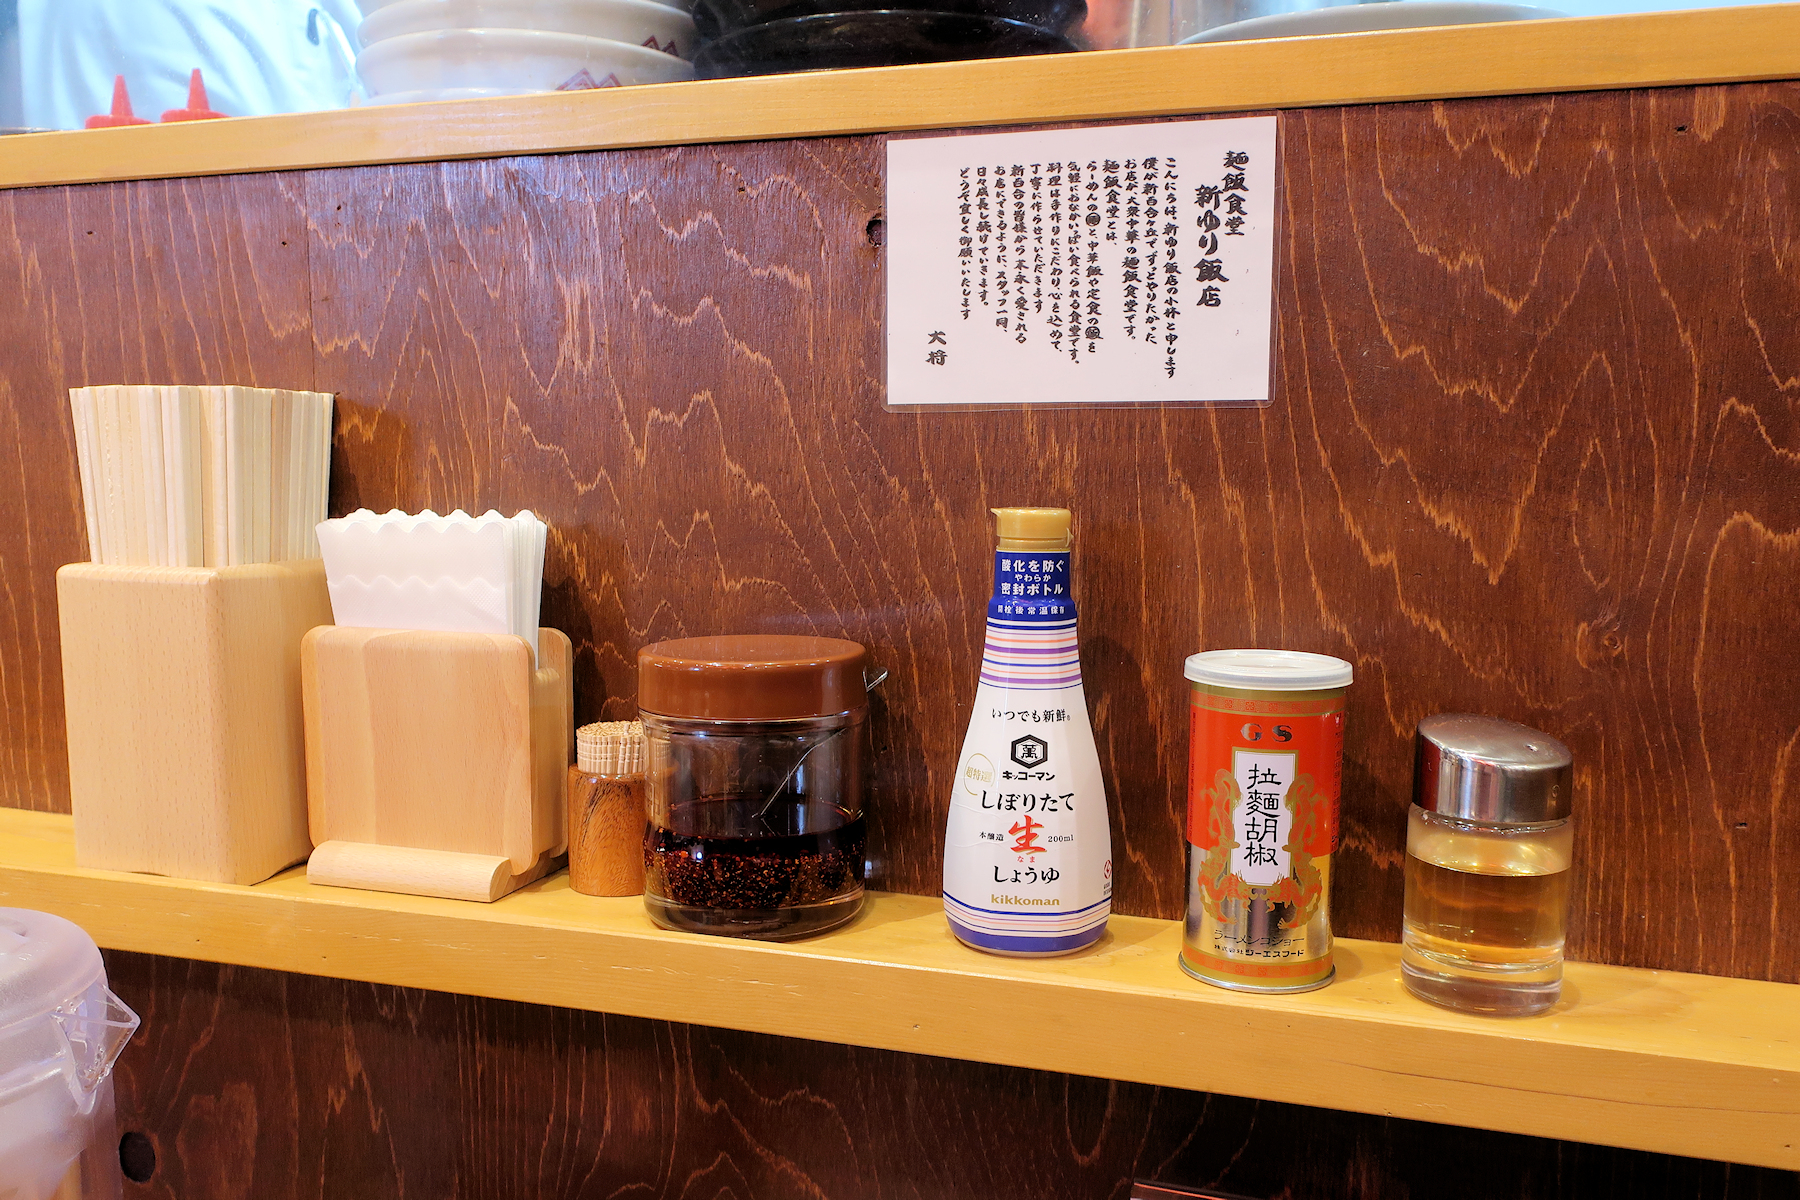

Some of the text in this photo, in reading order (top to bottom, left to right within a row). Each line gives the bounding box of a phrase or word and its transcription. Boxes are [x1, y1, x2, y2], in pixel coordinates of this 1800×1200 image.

[1194, 184, 1230, 307] 新ゆり飯店
[926, 330, 949, 366] 大将
[1001, 559, 1065, 573] 酸化を防ぐ
[1014, 574, 1052, 582] やわらか
[1001, 582, 1064, 596] 密封ボトル
[1002, 770, 1056, 781] キッコーマン
[981, 789, 1075, 813] しぼりたて
[1008, 814, 1047, 856] 生
[1047, 834, 1074, 843] 200ml
[993, 865, 1060, 885] しょうゆ
[990, 894, 1060, 906] kikkoman
[1214, 929, 1305, 947] ラーメンコショー
